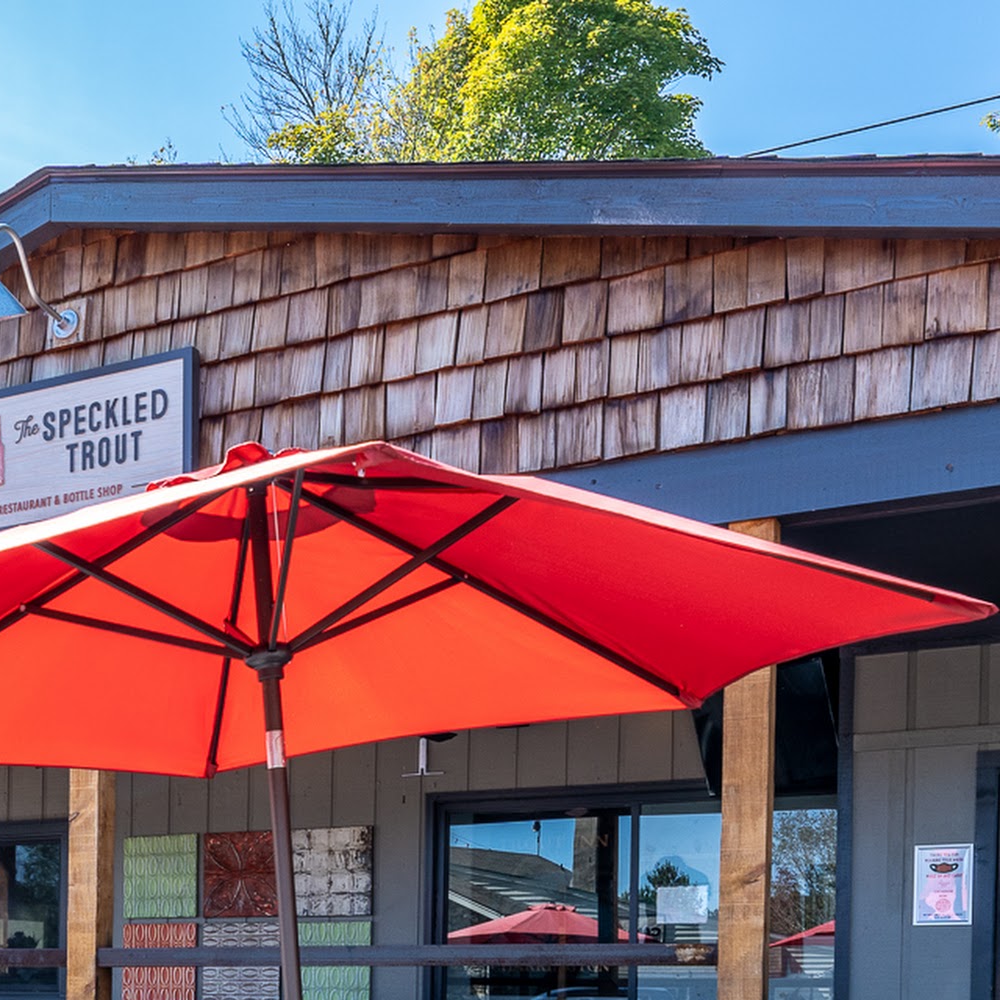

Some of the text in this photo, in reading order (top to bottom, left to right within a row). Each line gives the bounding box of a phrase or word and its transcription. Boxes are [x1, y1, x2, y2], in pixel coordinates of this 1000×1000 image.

[14, 388, 169, 444] The SPECKLED
[66, 430, 143, 473] TROUT
[54, 495, 61, 506] &
[63, 488, 95, 504] BOTTLE
[97, 484, 123, 498] SHOP
